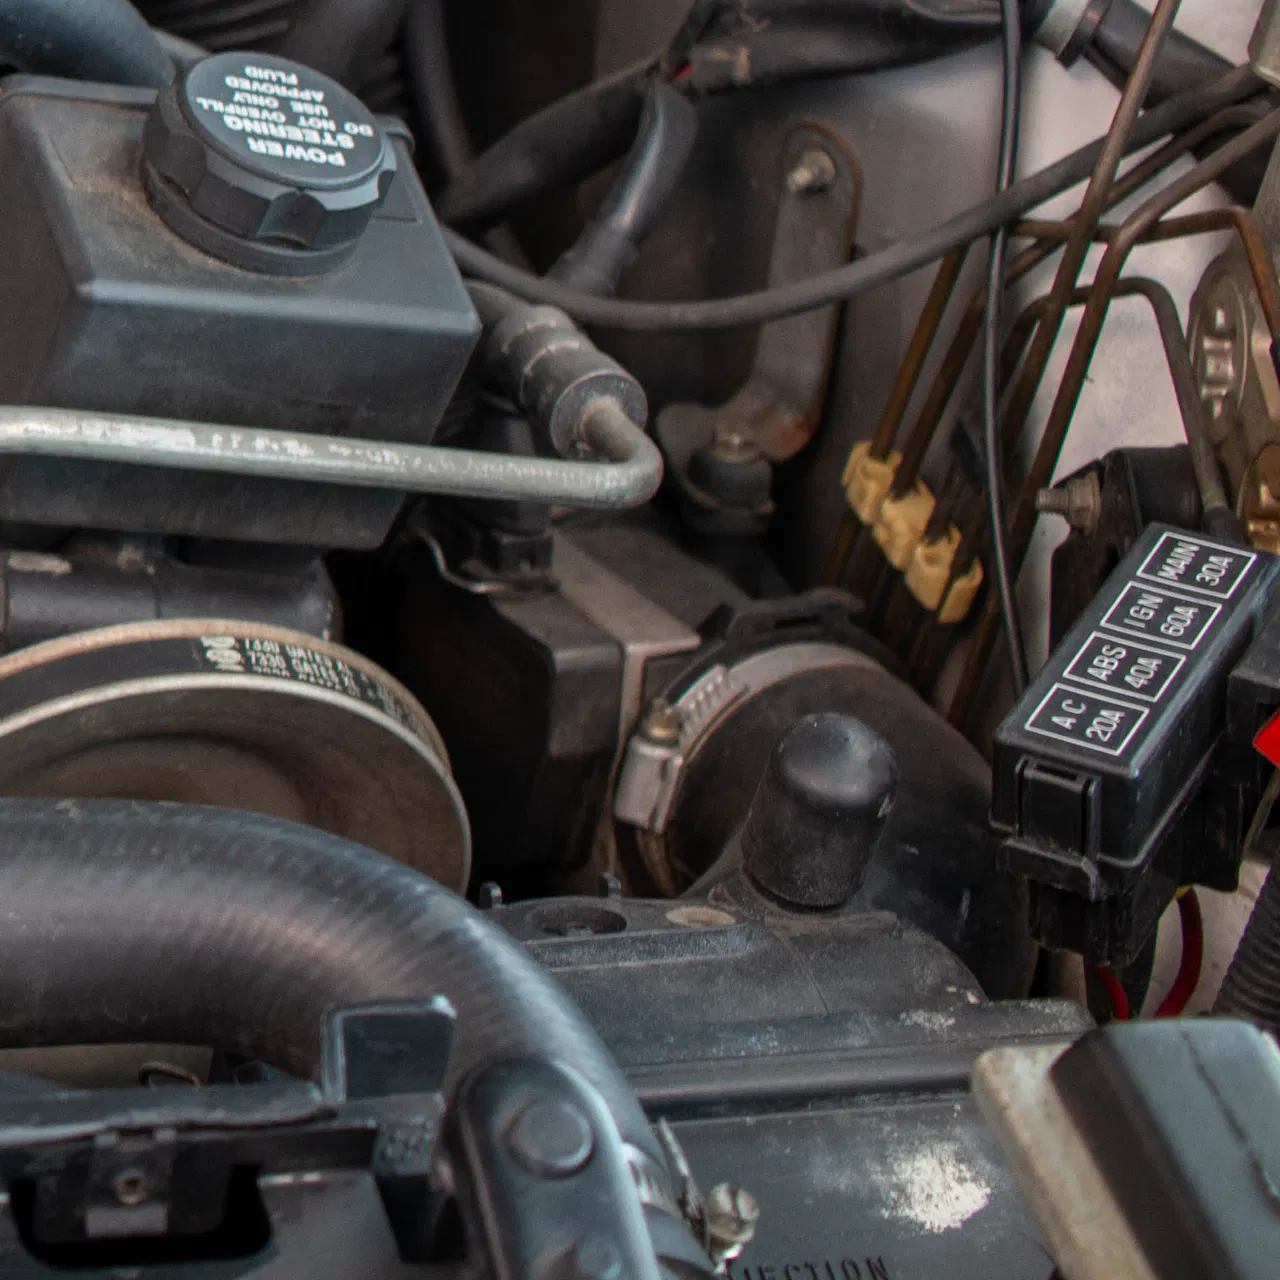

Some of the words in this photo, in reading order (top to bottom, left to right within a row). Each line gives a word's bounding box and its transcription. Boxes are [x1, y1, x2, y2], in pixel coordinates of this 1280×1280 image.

[224, 75, 325, 103] APPROVED
[244, 65, 299, 86] FLUID
[196, 96, 287, 124] OVERFILL
[232, 91, 280, 109] ONLY
[290, 101, 329, 117] USE
[223, 114, 355, 150] STEERING
[297, 115, 337, 133] NOT
[343, 121, 374, 138] DO
[245, 136, 346, 167] POWER
[1157, 540, 1200, 581] MAIN
[1196, 555, 1233, 587] 30A
[1123, 593, 1164, 628] IGN
[1160, 605, 1199, 637] 60A
[1087, 644, 1127, 682] ABS
[1124, 656, 1162, 690] 40A
[1085, 709, 1125, 742] 20A
